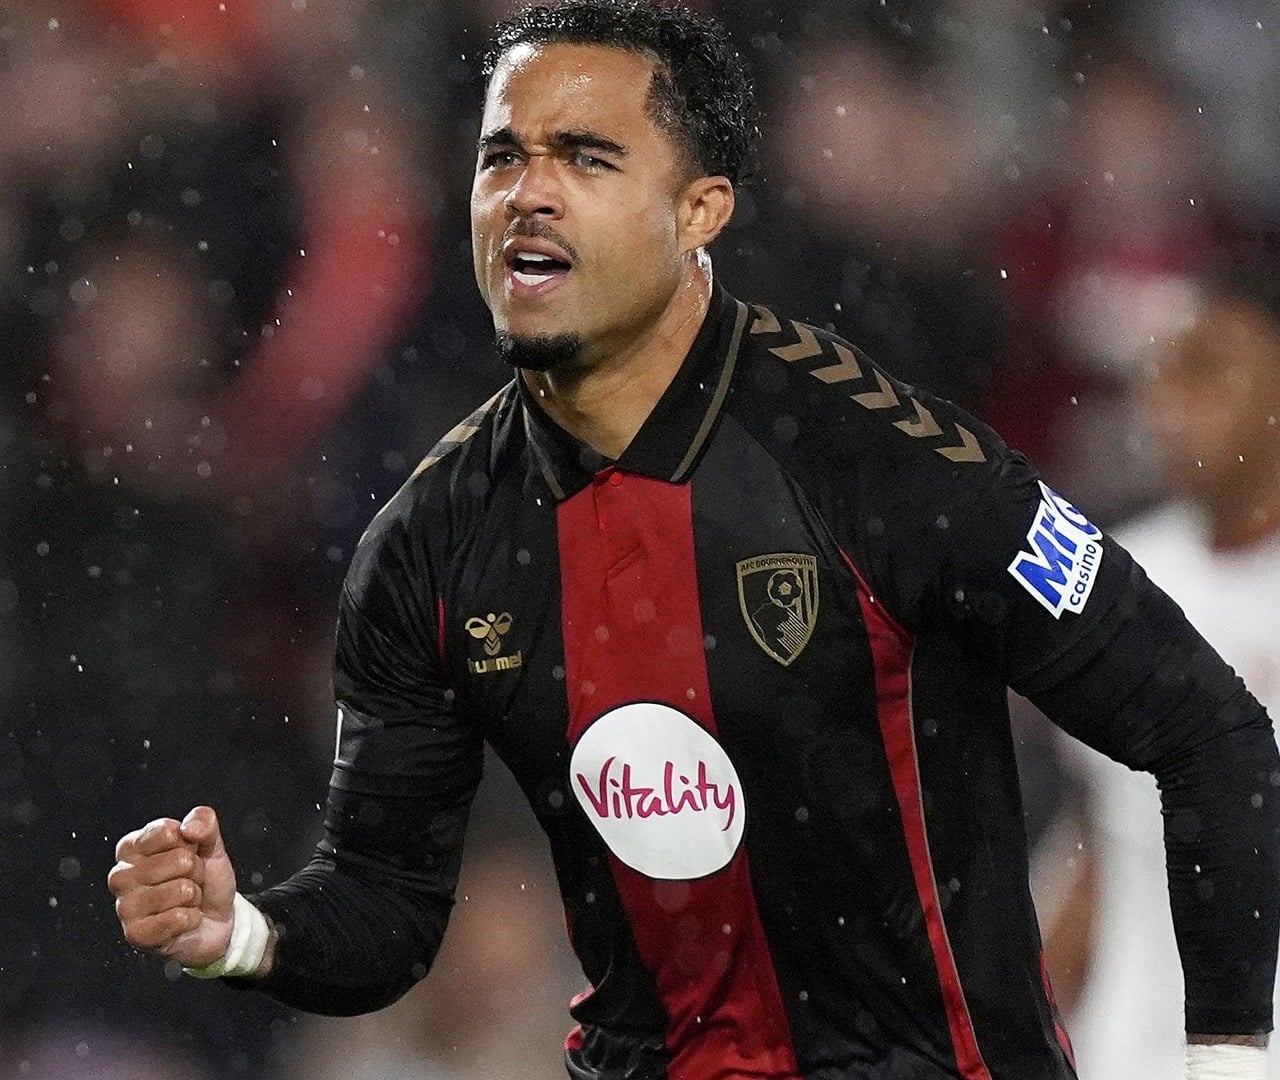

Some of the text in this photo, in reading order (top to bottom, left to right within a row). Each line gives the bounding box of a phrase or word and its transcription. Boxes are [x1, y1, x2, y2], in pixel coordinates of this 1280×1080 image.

[740, 560, 755, 572] AFC
[1069, 543, 1097, 607] casino
[576, 756, 735, 832] Vitality
